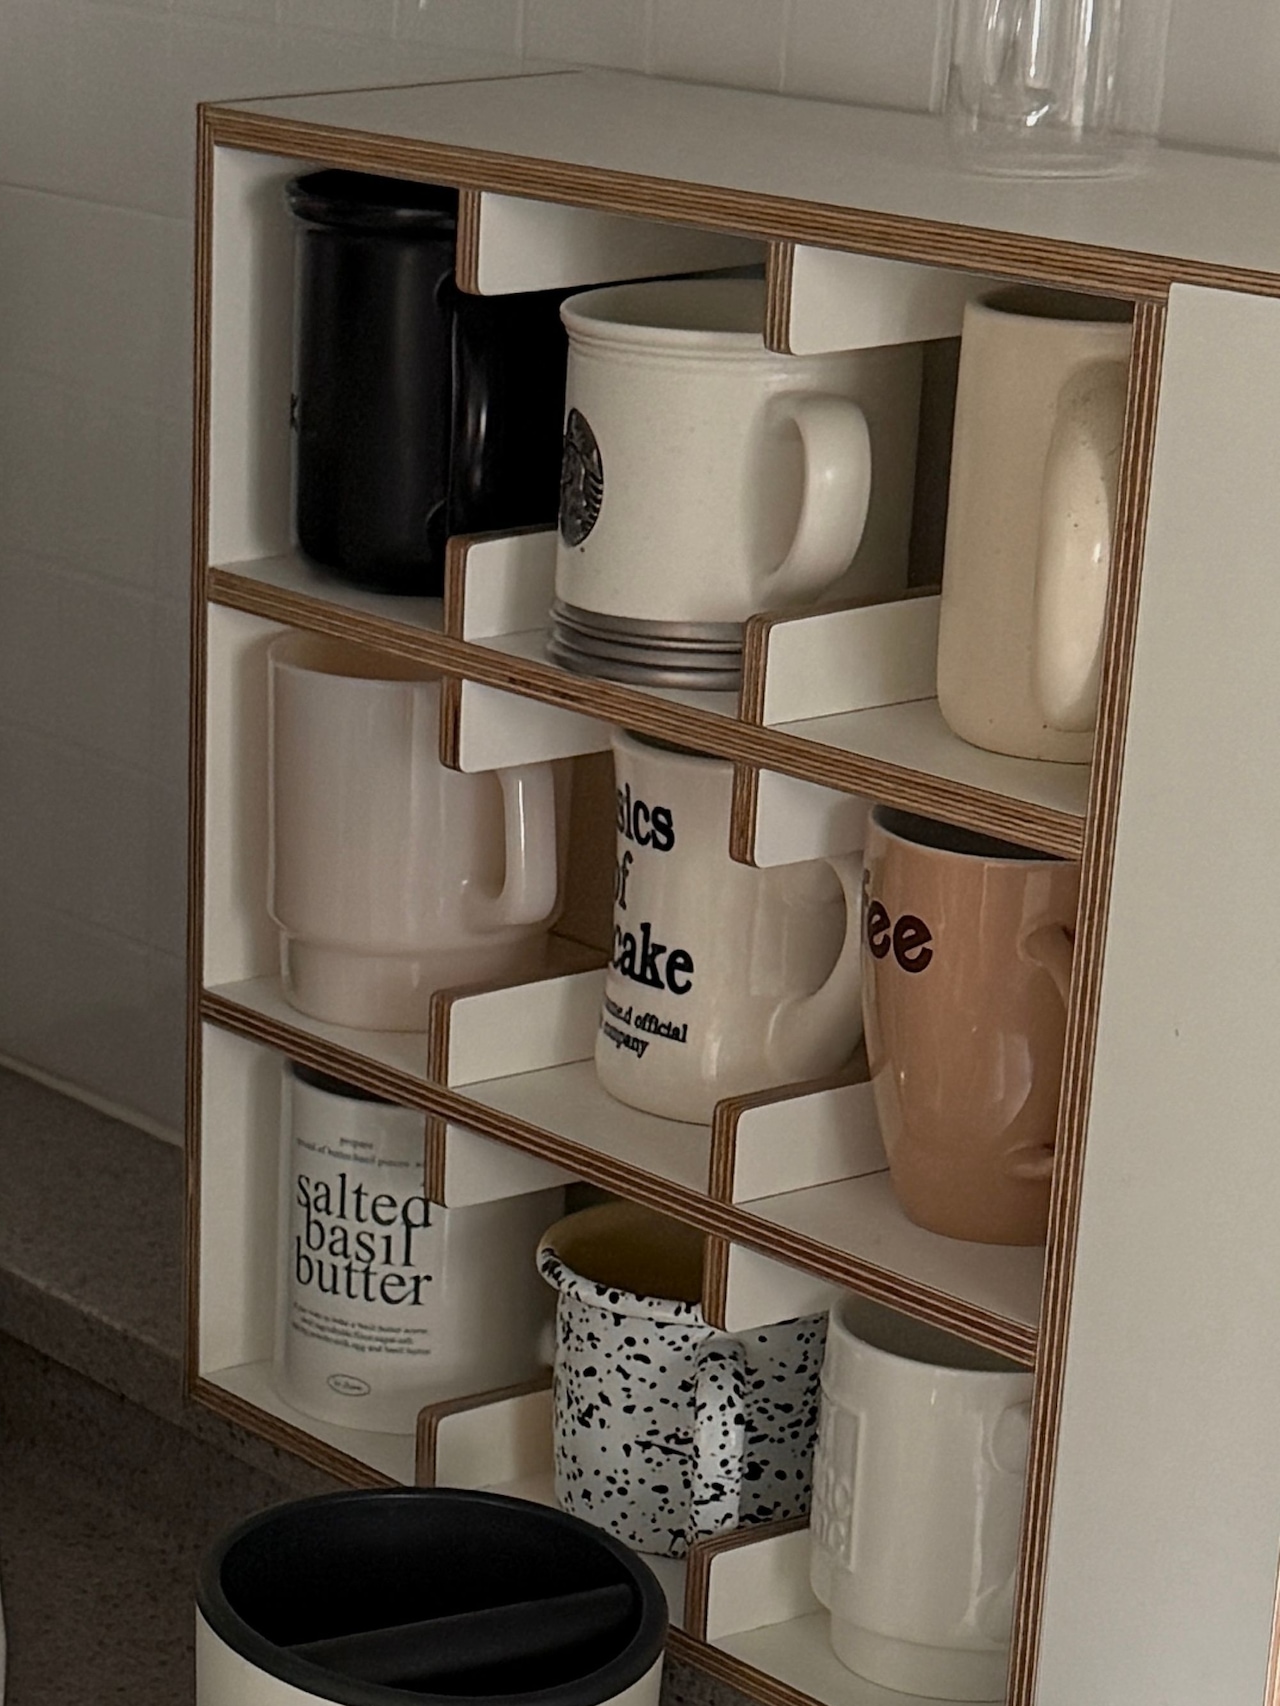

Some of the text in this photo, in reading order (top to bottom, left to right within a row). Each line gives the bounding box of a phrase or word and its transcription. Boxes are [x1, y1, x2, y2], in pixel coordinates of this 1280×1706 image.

[634, 1012, 688, 1043] official
[297, 1172, 432, 1229] salted
[306, 1202, 415, 1267] basil
[296, 1235, 433, 1306] butter
